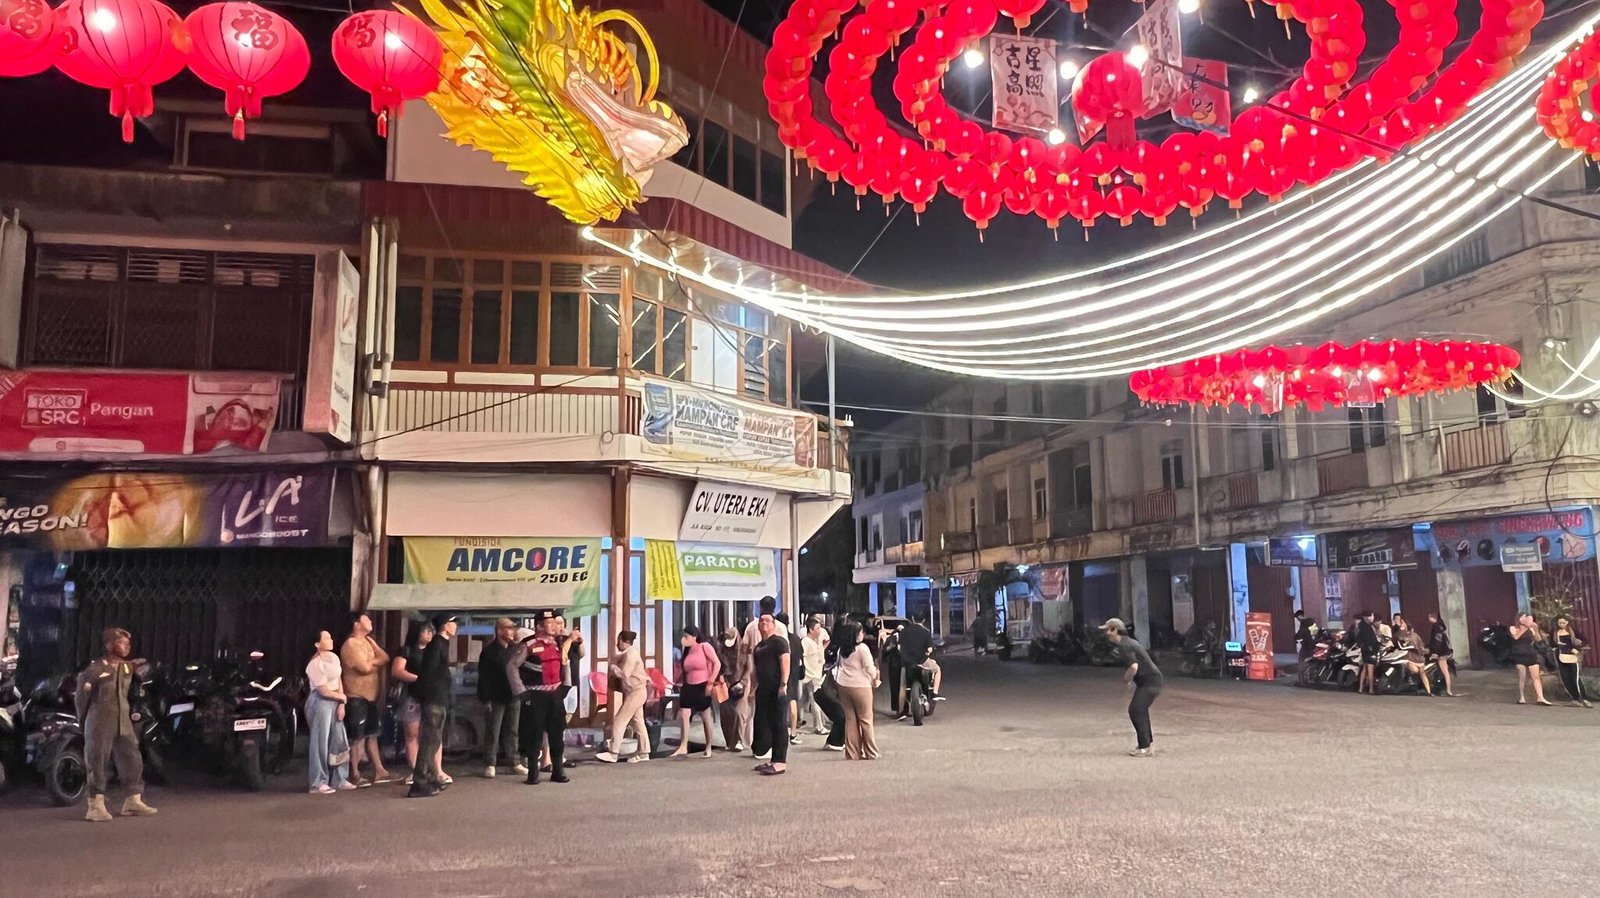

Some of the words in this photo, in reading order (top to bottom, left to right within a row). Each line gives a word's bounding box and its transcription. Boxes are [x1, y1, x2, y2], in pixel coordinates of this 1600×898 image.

[231, 9, 279, 50] 福
[342, 13, 376, 48] 福
[34, 395, 76, 407] TOKO
[41, 410, 80, 425] SRC
[90, 402, 154, 419] Pangan
[695, 490, 714, 512] CV.
[713, 493, 748, 516] UTERA
[747, 497, 769, 517] EKA
[0, 513, 89, 535] ASON!
[275, 515, 299, 523] ICE
[447, 545, 588, 572] AMCORE
[684, 555, 757, 569] PARATOP
[540, 572, 568, 584] 250
[572, 570, 588, 582] EC
